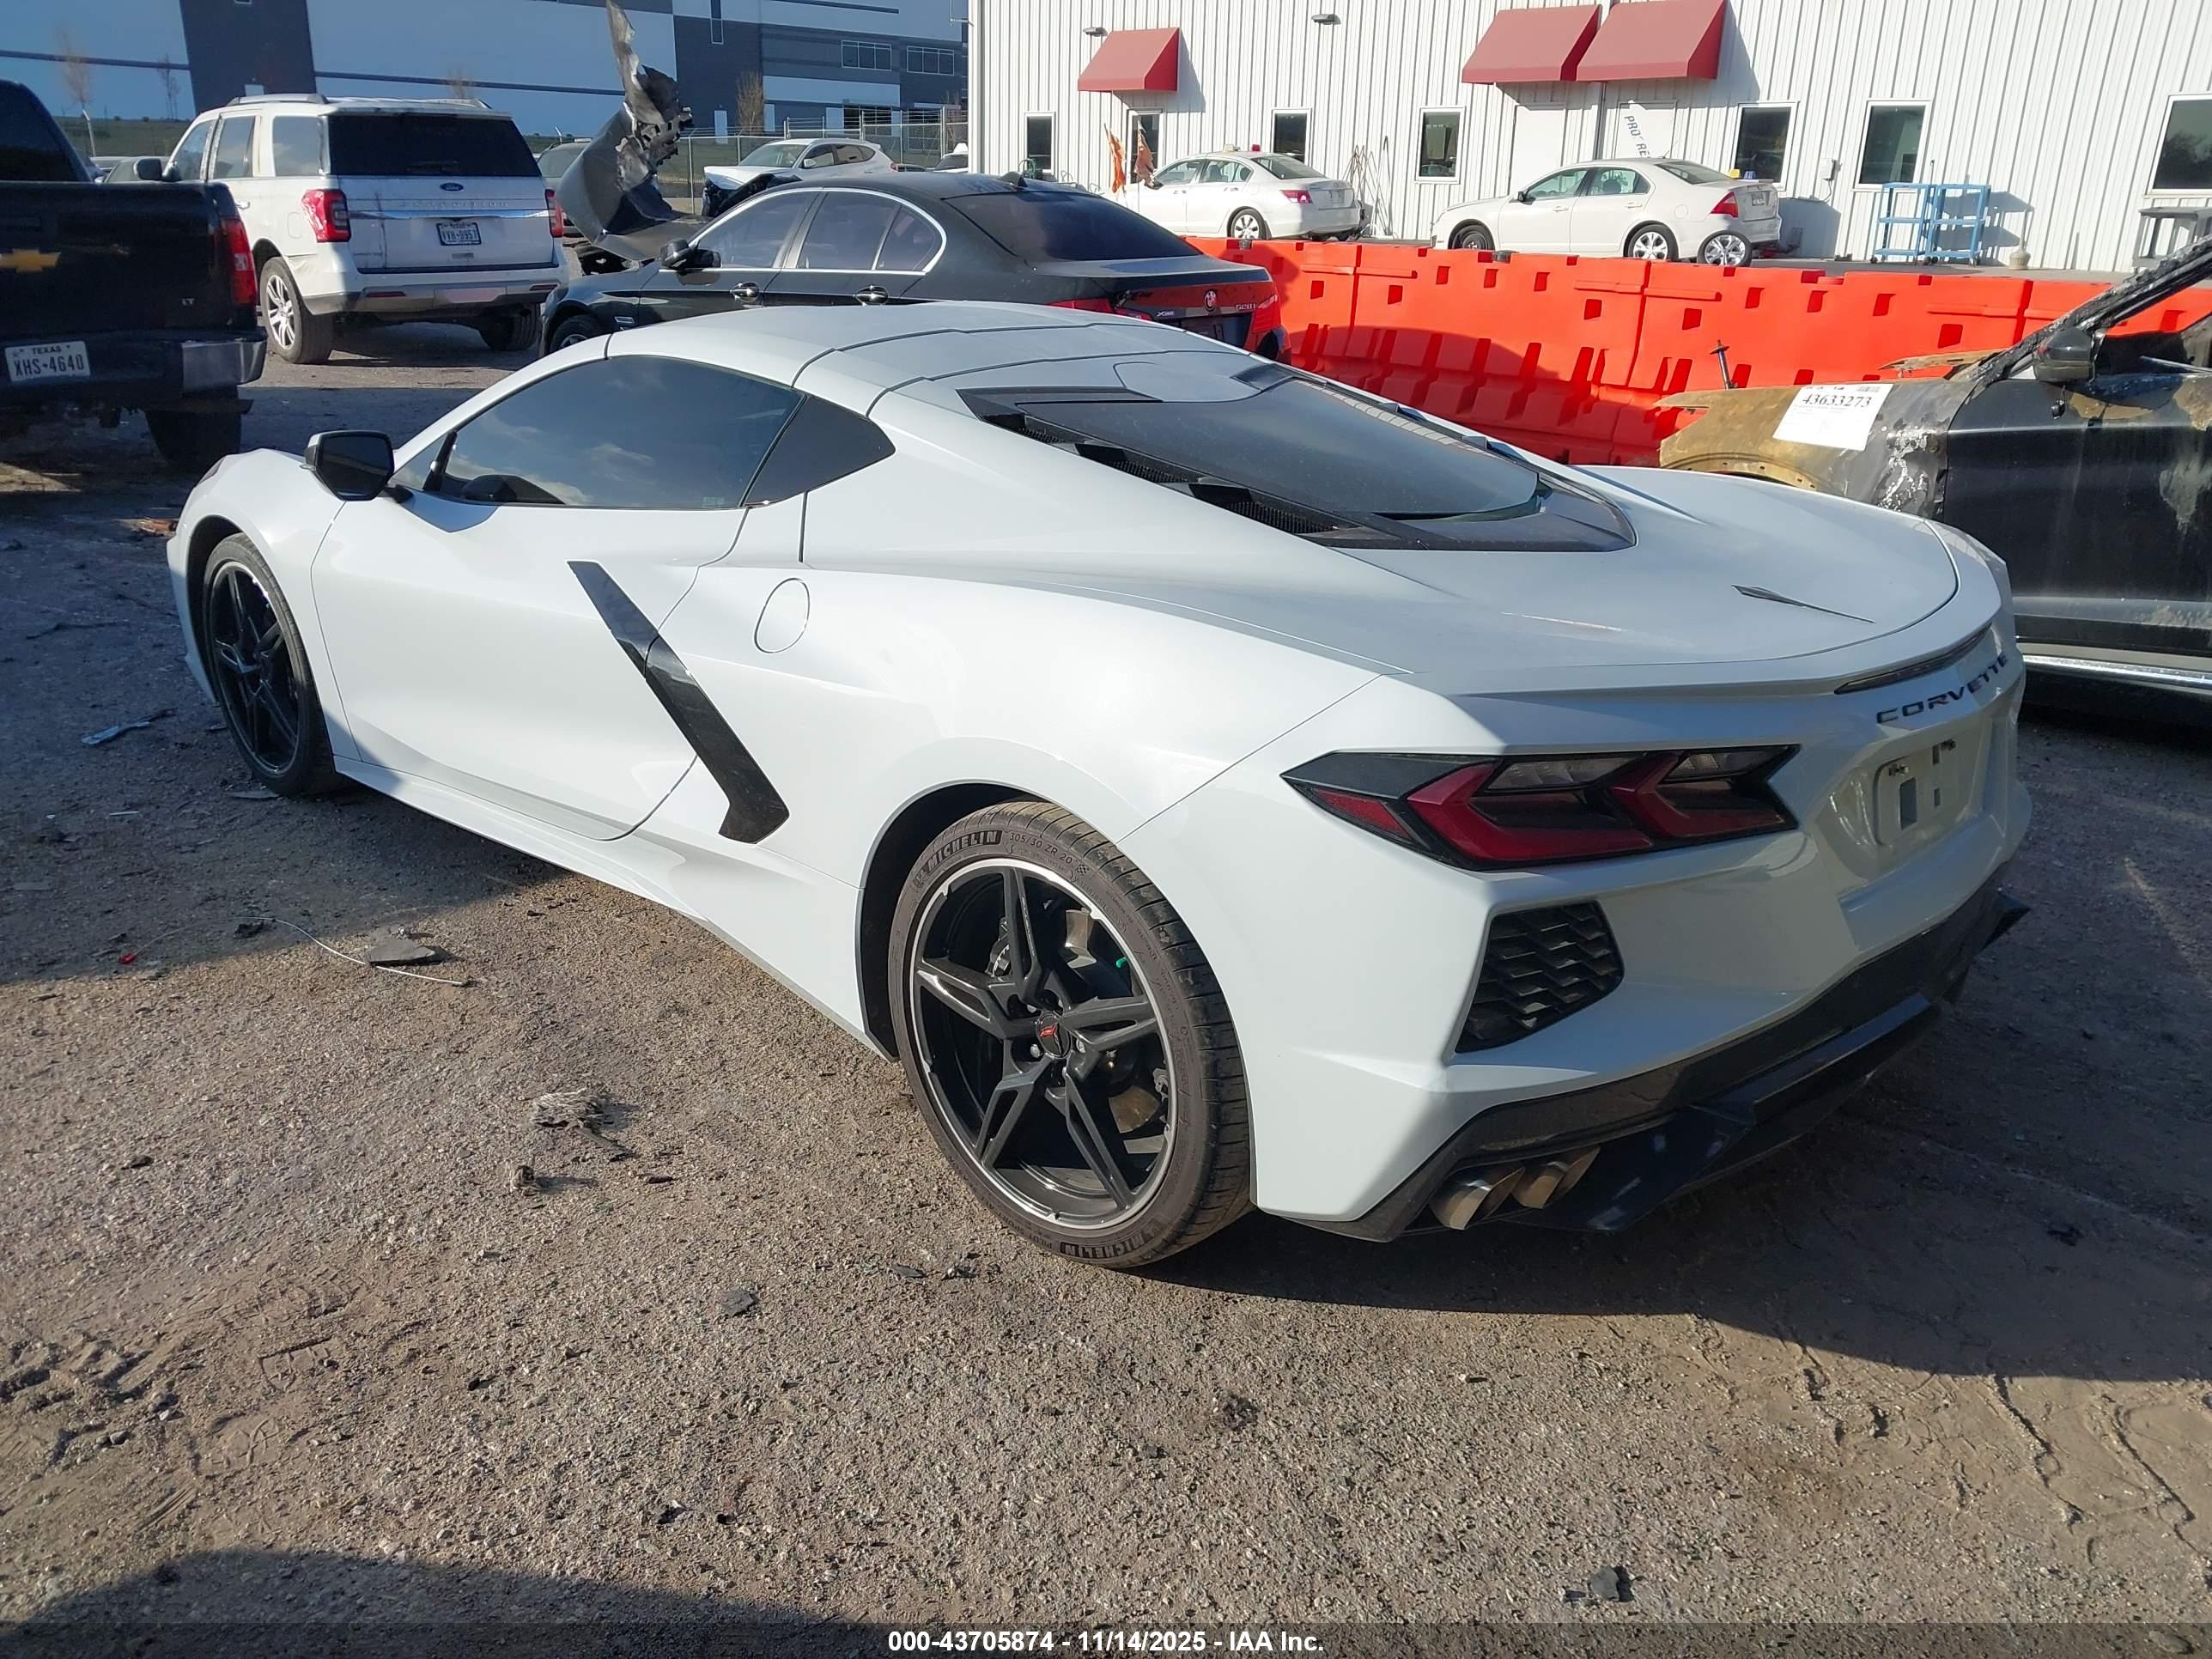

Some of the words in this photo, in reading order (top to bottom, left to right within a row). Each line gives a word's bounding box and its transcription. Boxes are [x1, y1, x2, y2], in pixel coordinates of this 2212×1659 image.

[32, 345, 62, 355] TEXAS
[1802, 393, 1873, 408] 43633273
[1876, 653, 2008, 724] CORVETTE
[927, 830, 998, 870] MICHELIN
[1009, 832, 1042, 848] 305/30
[1044, 843, 1057, 856] ZR
[1060, 853, 1073, 864] 20
[1066, 1233, 1145, 1258] MICHELIN
